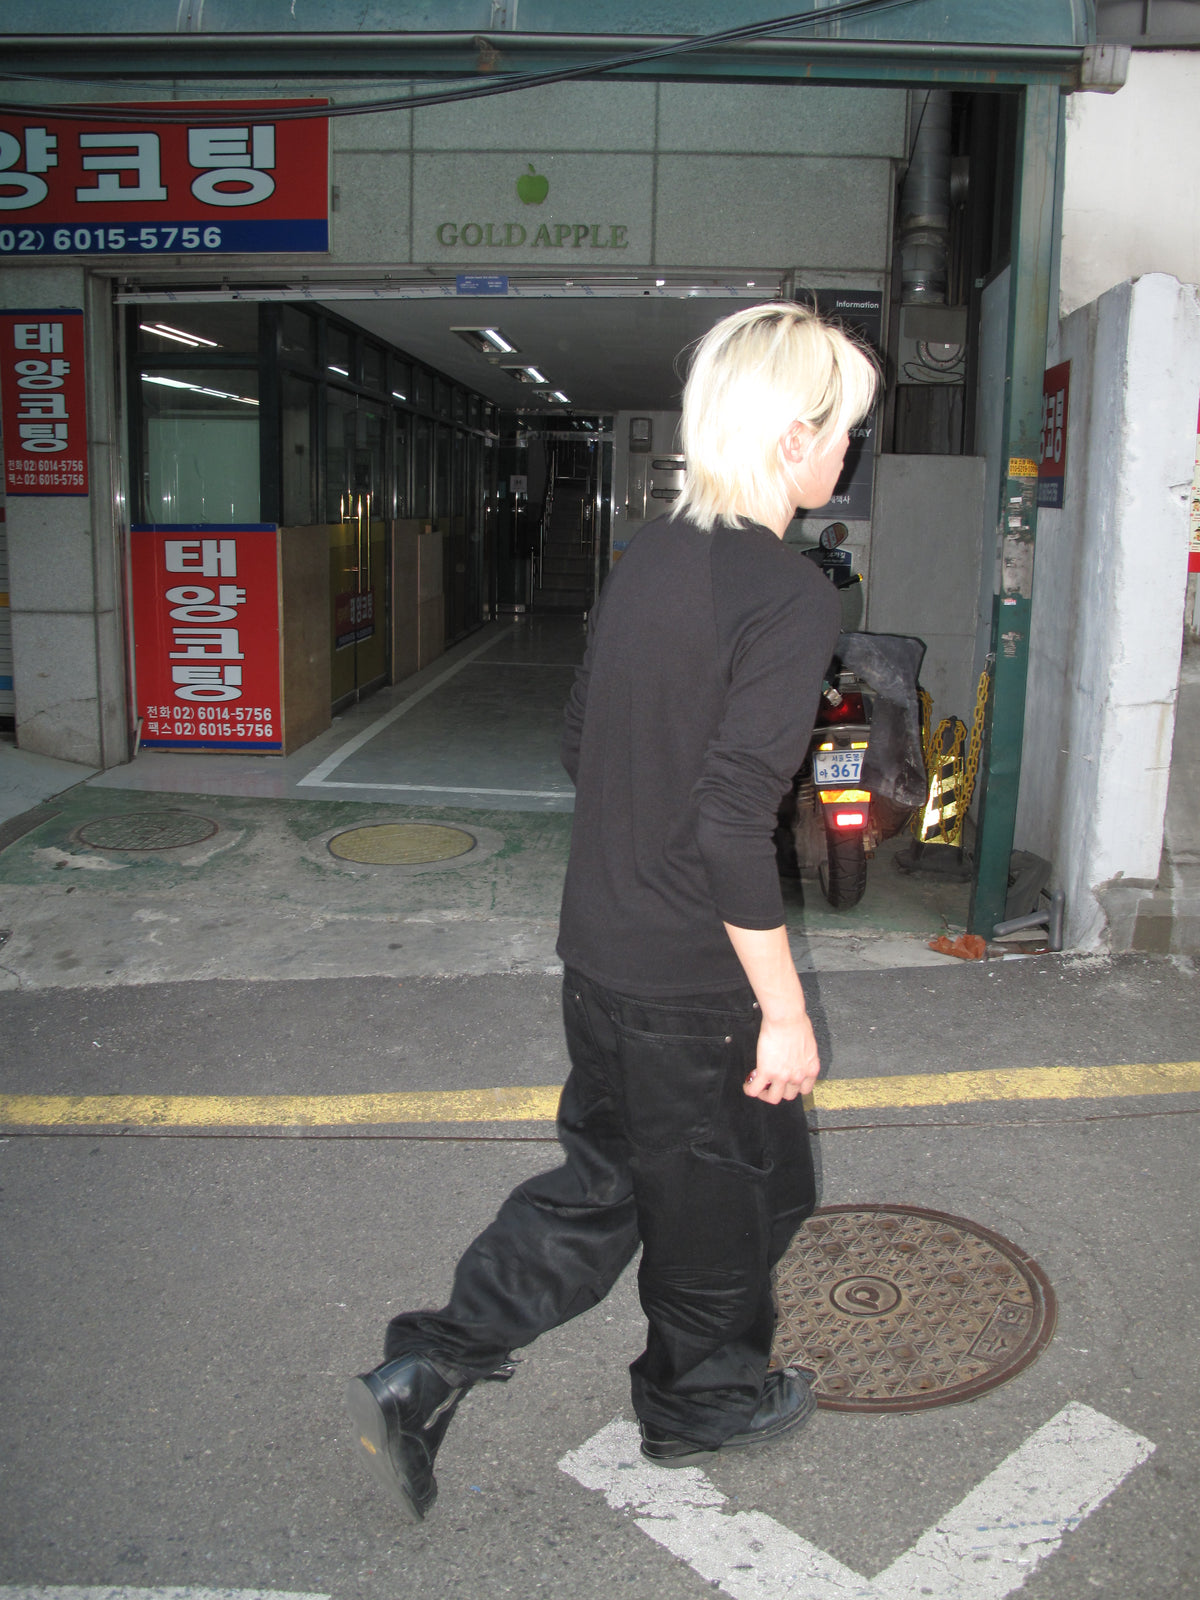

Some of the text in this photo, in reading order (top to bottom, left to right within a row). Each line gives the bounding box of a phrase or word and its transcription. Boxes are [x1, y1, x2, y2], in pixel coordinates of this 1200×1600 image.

[0, 123, 276, 210] 양코팅
[53, 227, 222, 251] 6015-5756
[436, 222, 629, 249] GOLD APPLE
[836, 300, 879, 309] Information
[14, 322, 70, 453] 태양코팅
[7, 459, 23, 471] 전화
[38, 459, 84, 471] 6014-5756
[8, 473, 24, 486] 팩스
[39, 473, 85, 486] 6015-5756
[164, 538, 248, 703] 태양코팅
[147, 705, 272, 722] 전화 02) 6014-5756
[147, 721, 273, 737] 팩스 02) 6015-5756
